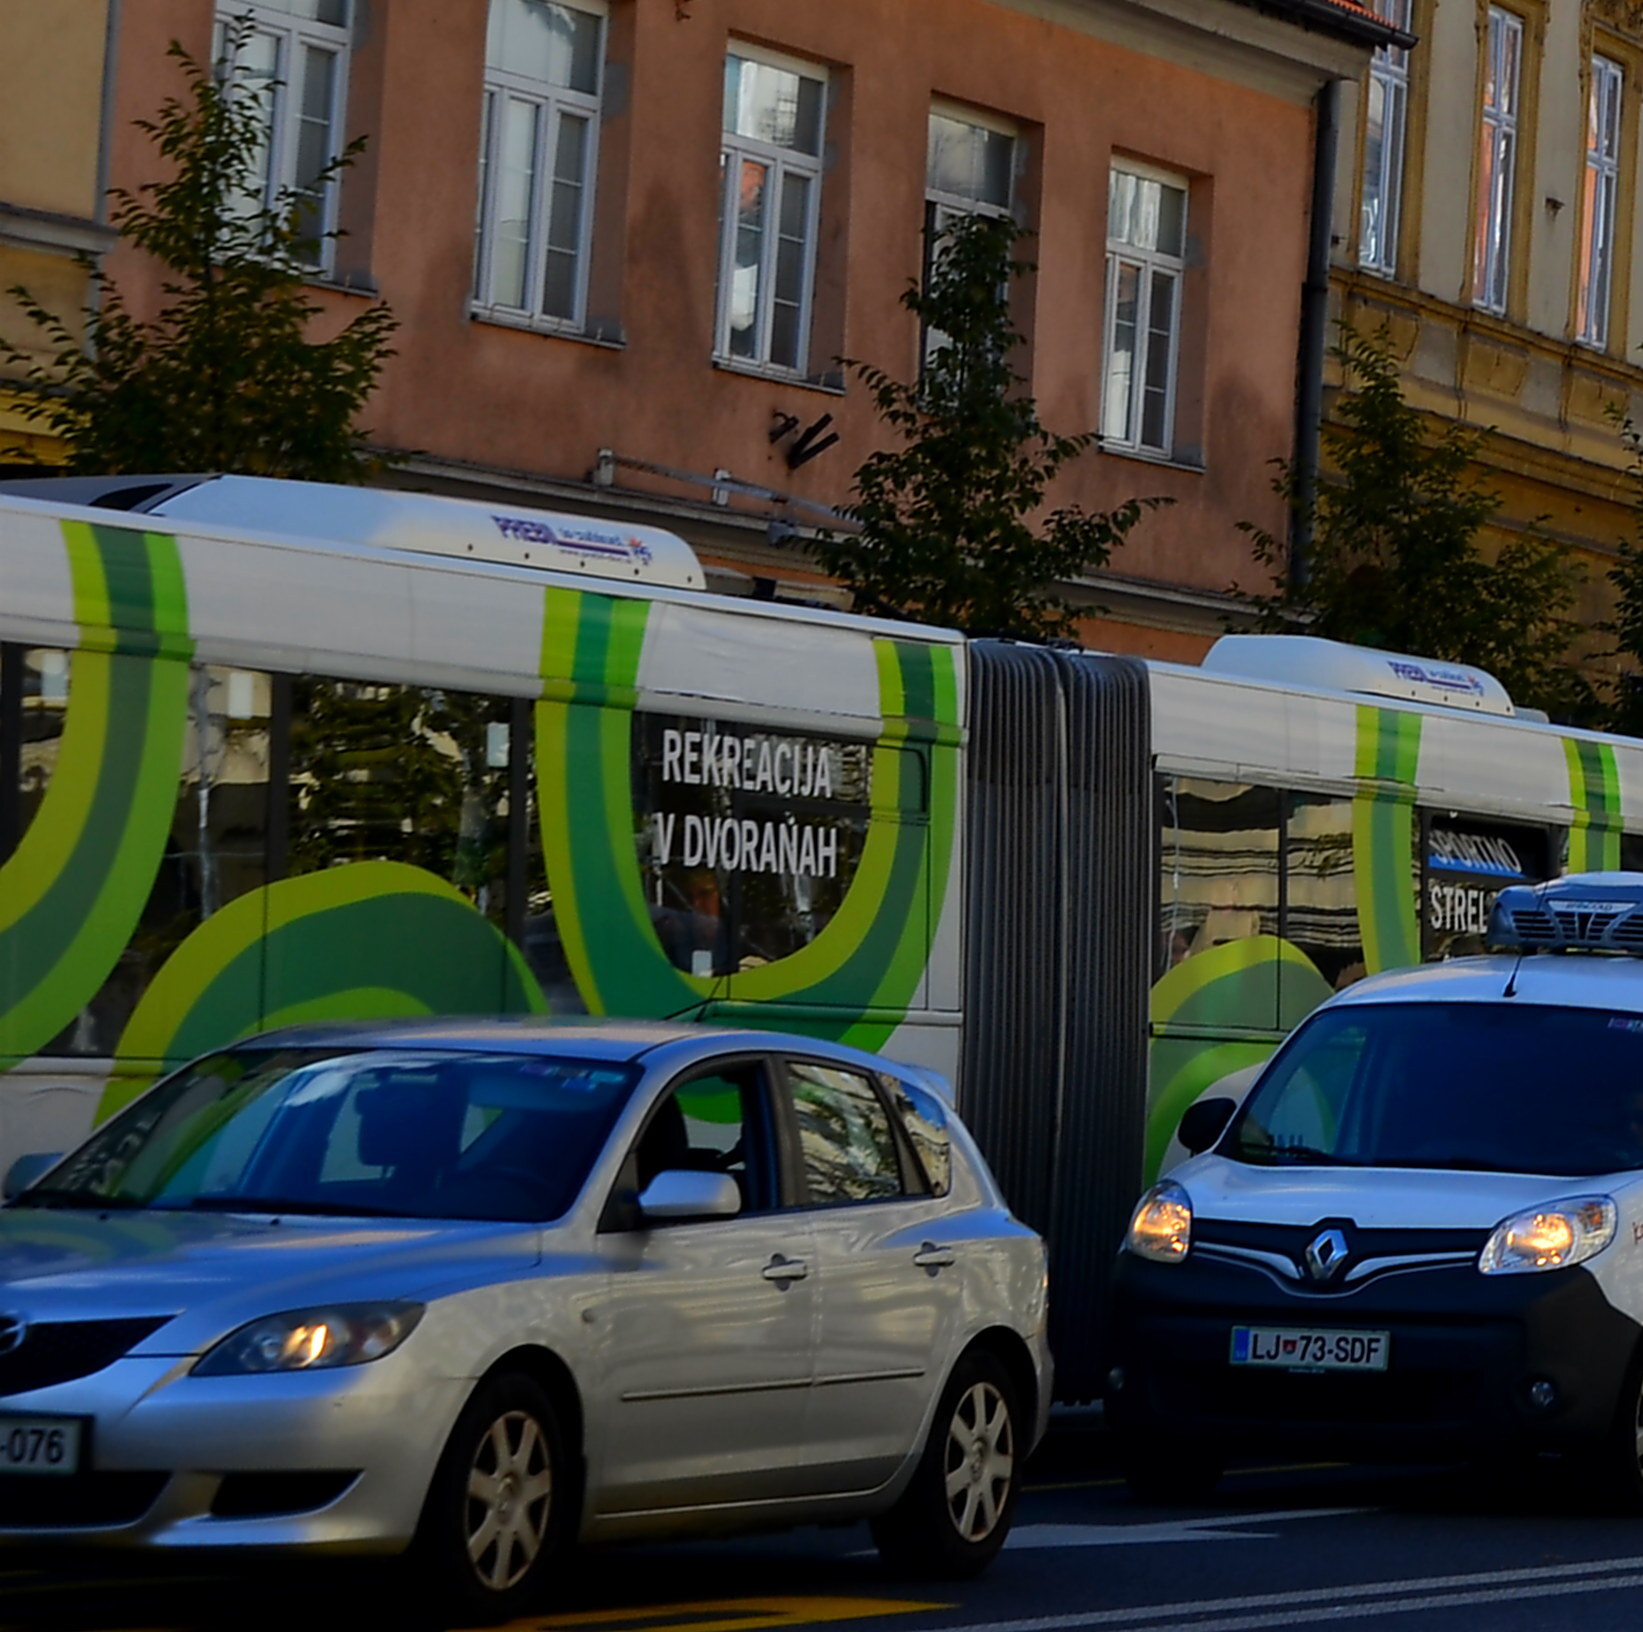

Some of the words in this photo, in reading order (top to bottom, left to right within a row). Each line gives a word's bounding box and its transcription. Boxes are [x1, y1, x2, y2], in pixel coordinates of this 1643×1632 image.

[663, 729, 832, 799] REKREACIJA
[653, 811, 675, 865] V
[683, 814, 837, 879] DVORANAH
[1430, 885, 1491, 935] STREL
[1251, 1334, 1281, 1360] LJ
[1299, 1335, 1381, 1364] 73-SDF
